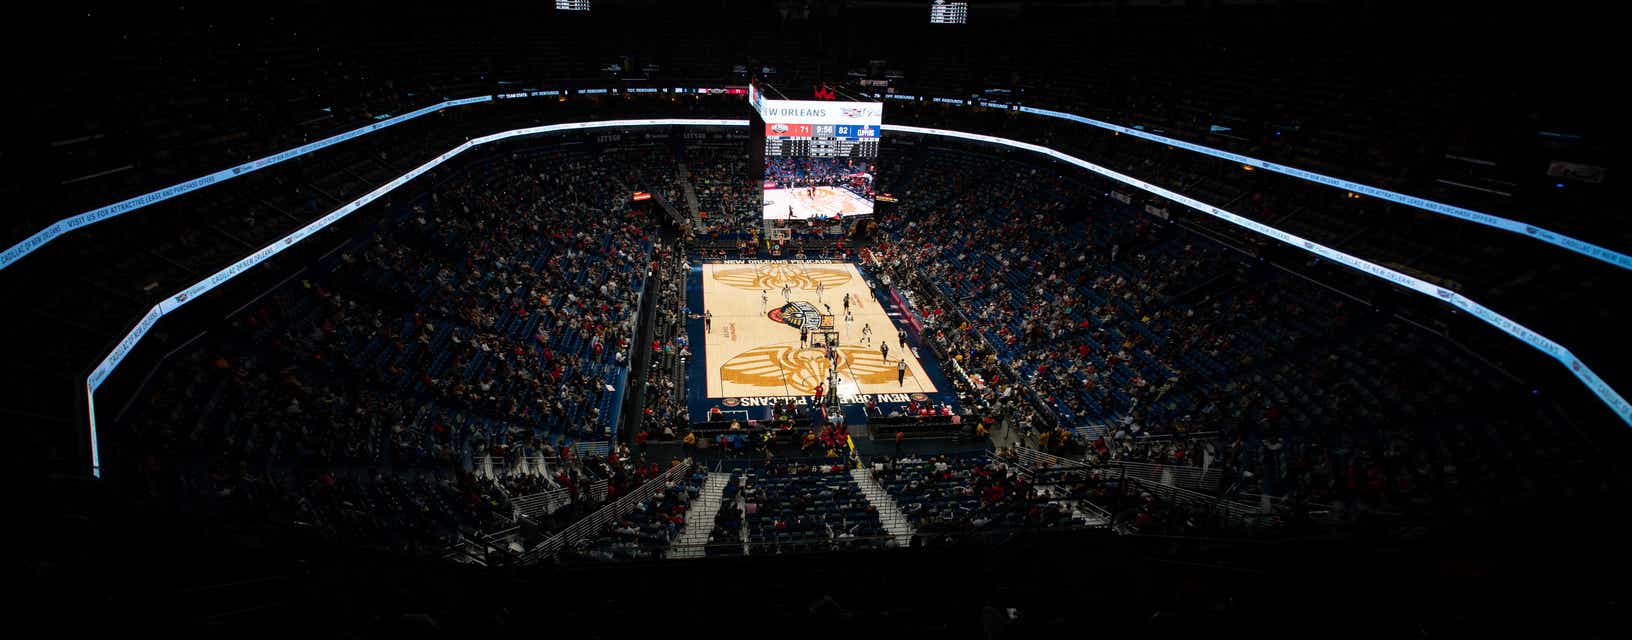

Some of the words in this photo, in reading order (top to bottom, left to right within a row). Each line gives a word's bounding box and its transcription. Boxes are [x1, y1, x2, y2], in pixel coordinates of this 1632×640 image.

[781, 107, 826, 118] ORLEANS
[816, 125, 833, 134] 9:56
[838, 126, 848, 134] 82
[67, 216, 85, 227] VISIT
[86, 213, 96, 221] US
[97, 208, 109, 218] FOR
[877, 393, 912, 403] NEW
